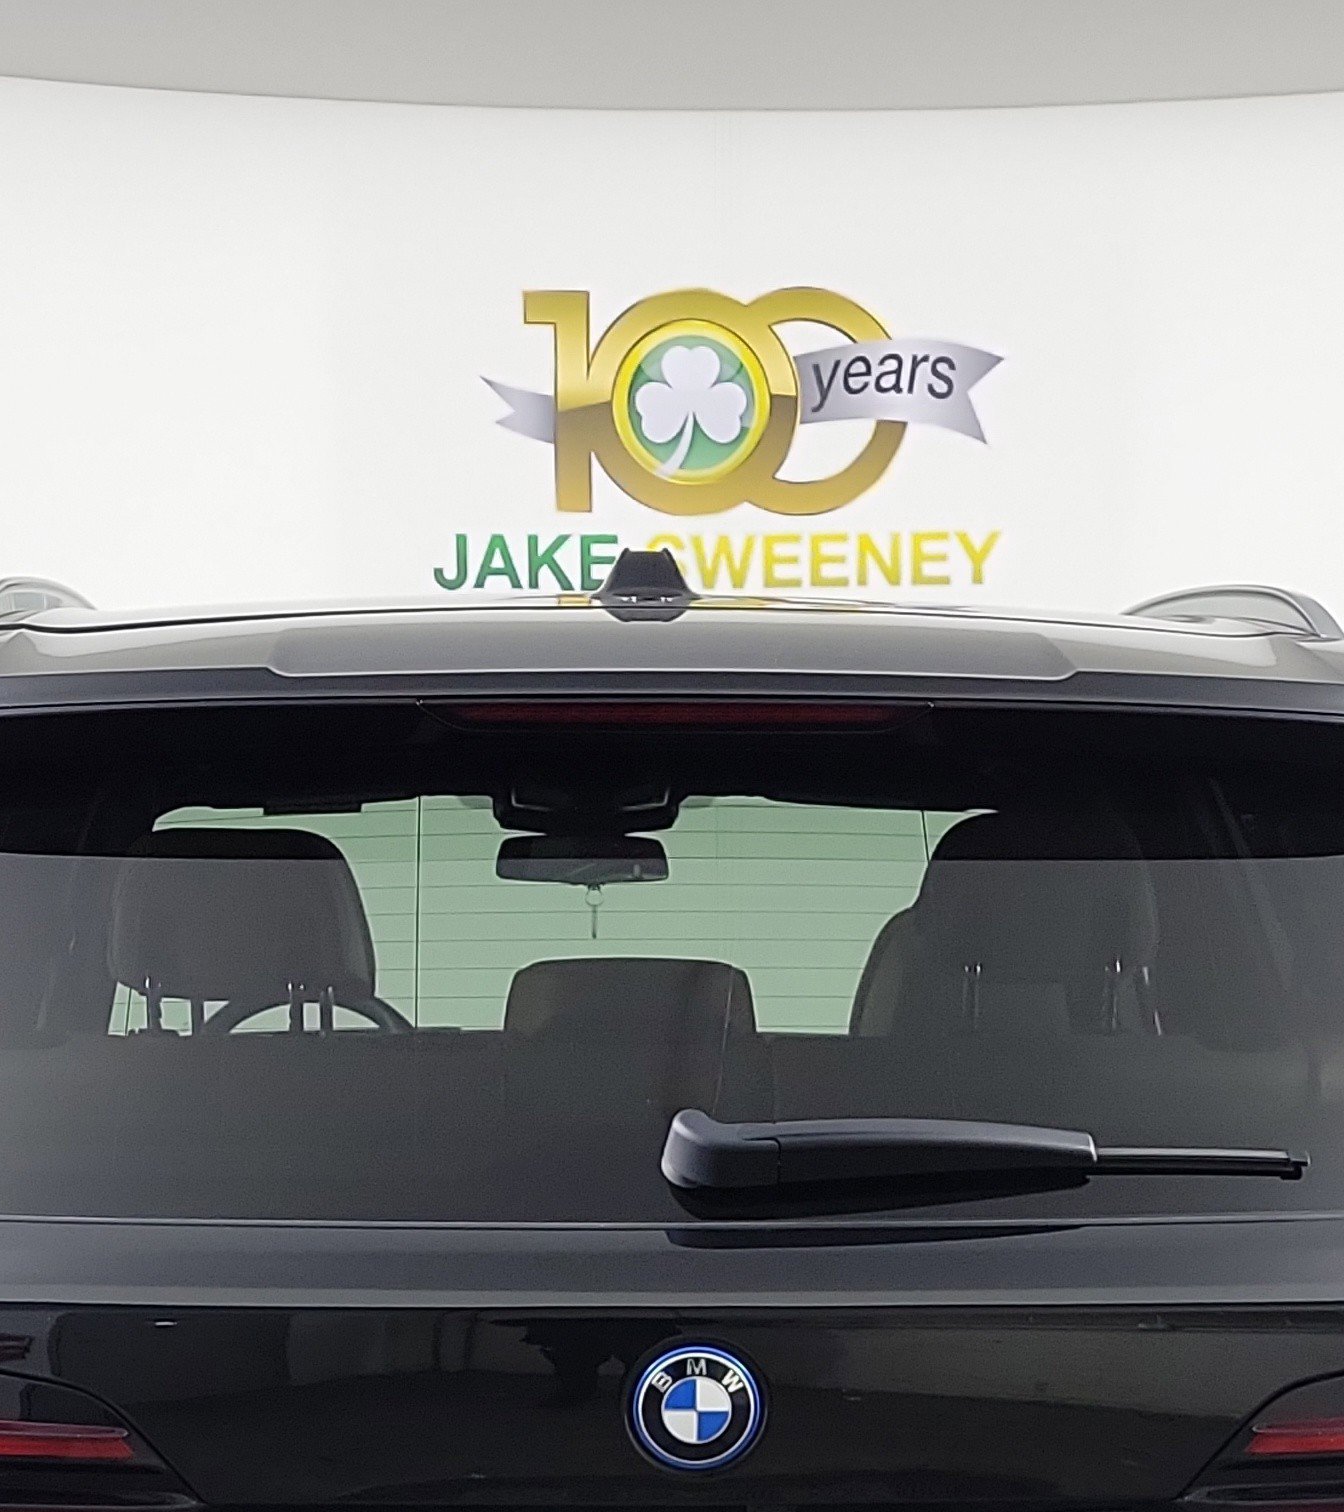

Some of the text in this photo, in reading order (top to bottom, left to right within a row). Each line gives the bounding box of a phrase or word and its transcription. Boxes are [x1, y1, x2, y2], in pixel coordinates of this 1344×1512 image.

[810, 352, 957, 413] years
[433, 533, 619, 591] JAKE
[652, 1357, 745, 1394] BMW
